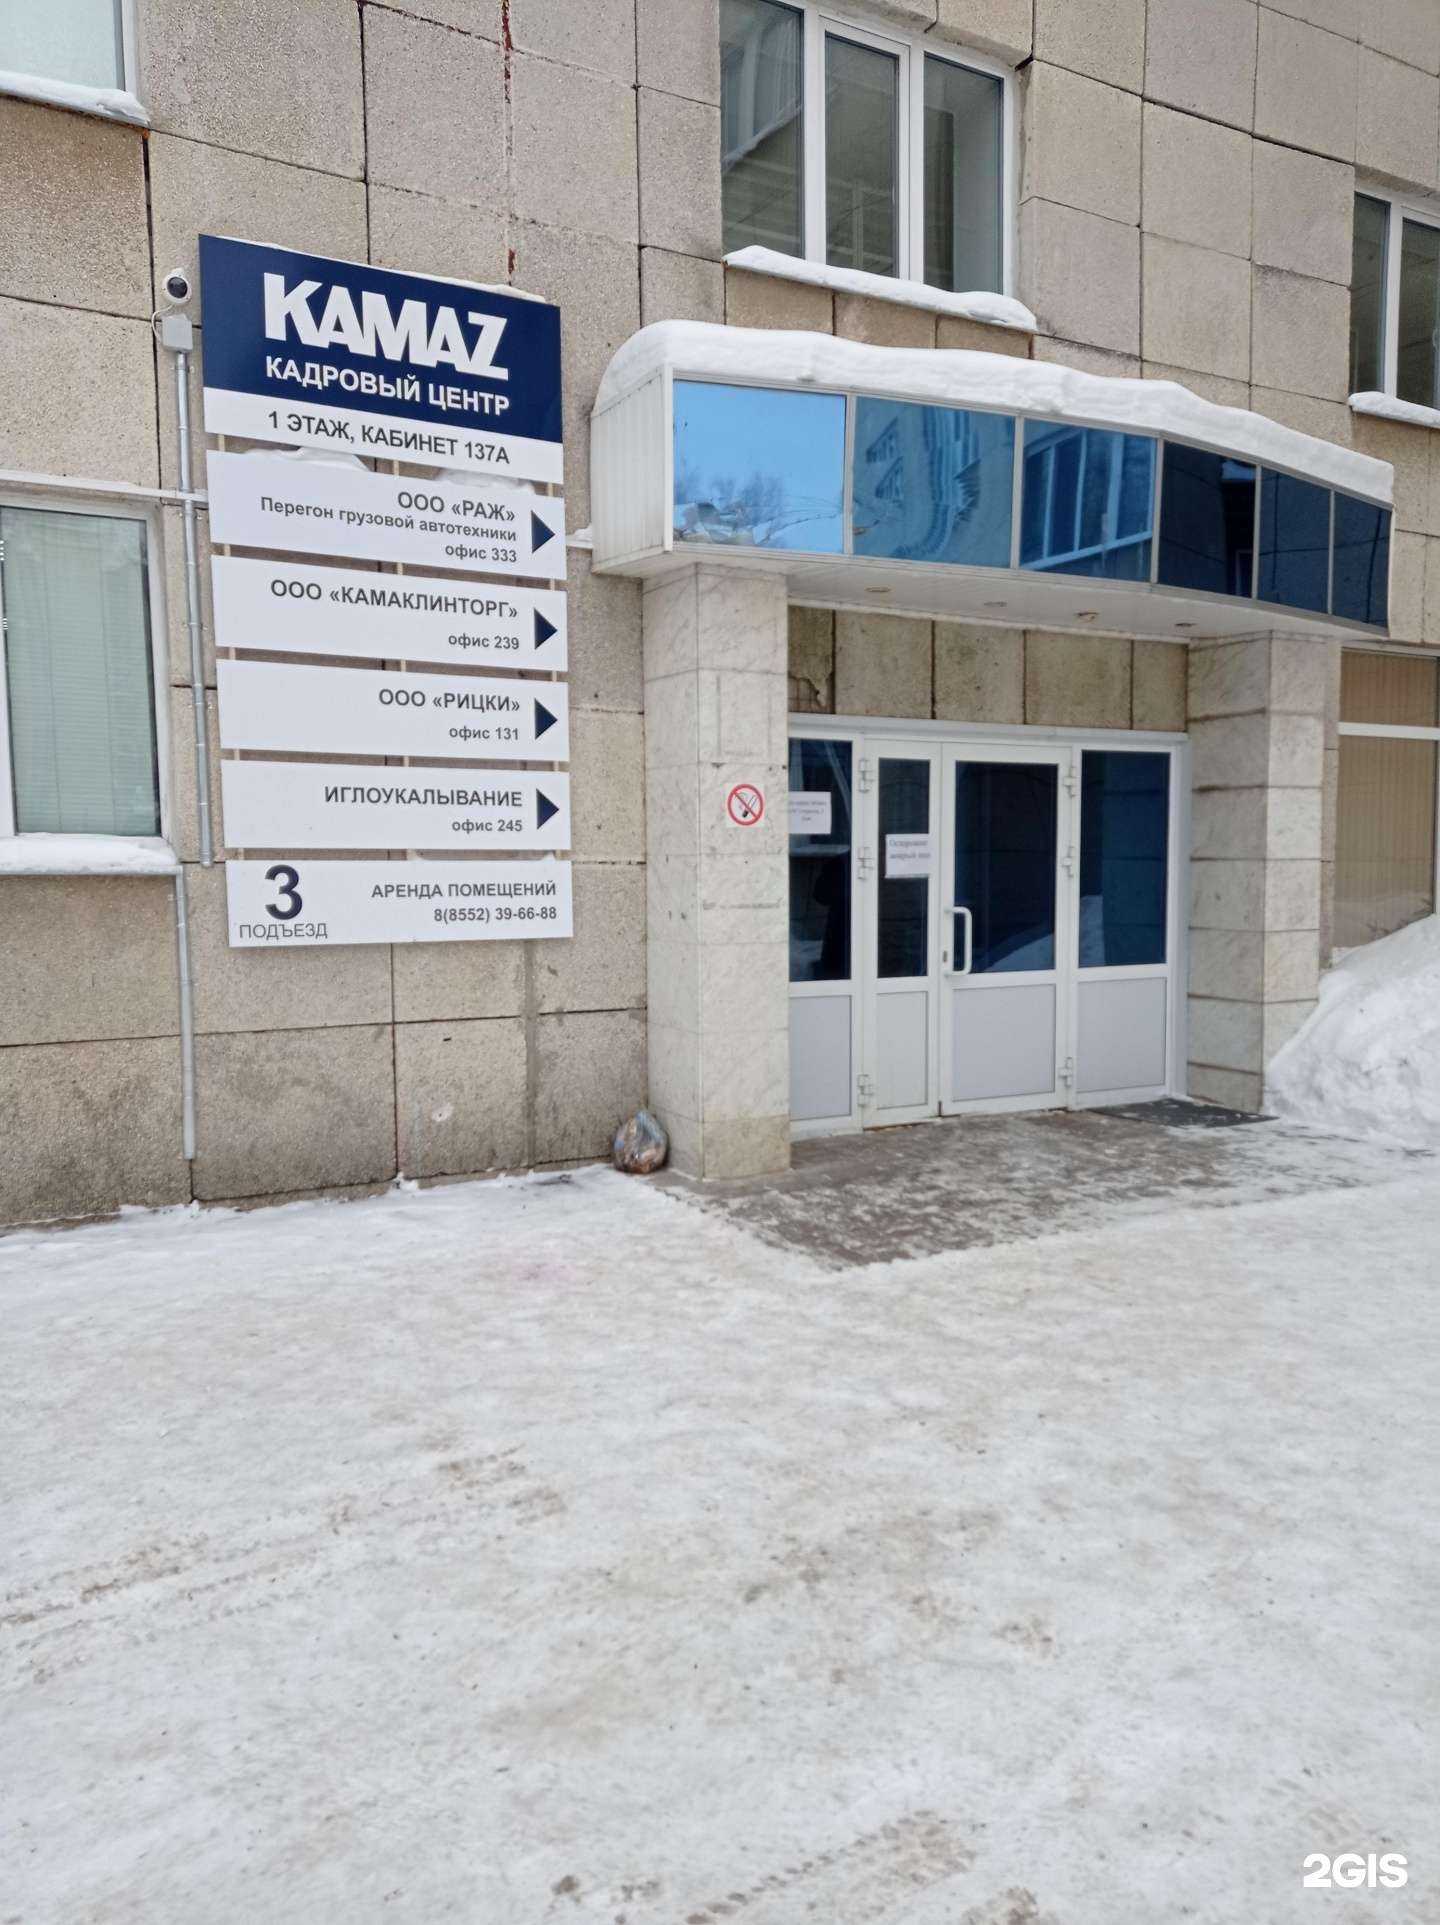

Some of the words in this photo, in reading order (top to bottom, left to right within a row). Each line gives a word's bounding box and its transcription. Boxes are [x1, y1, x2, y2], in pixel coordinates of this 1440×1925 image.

[263, 272, 509, 381] KAMAZ
[265, 355, 422, 402] КАДРОВЫЙ
[428, 386, 510, 416] ЦЕНТР
[269, 411, 277, 428] 1
[287, 414, 354, 443] ЭТАЖ,
[362, 425, 458, 455] КАБИНЕТ
[465, 441, 510, 464] 137А
[398, 492, 444, 512] ООО
[452, 500, 515, 521] «РАЖ»
[261, 497, 333, 518] Перегон
[339, 510, 414, 529] грузовой
[419, 521, 516, 541] автотехники
[445, 544, 486, 560] офис
[492, 548, 517, 563] 333
[271, 580, 321, 600] ООО
[330, 586, 517, 617] «КАМАКЛИНТОРГ»
[449, 633, 489, 649] офис
[494, 636, 519, 650] 239
[379, 689, 425, 707] ООО
[433, 693, 519, 713] «РИЦКИ»
[449, 726, 490, 741] офис
[496, 727, 518, 740] 131
[325, 786, 522, 807] ИГЛОУКАЛЫВАНИЕ
[452, 819, 492, 834] офис
[498, 819, 522, 832] 245
[264, 864, 303, 921] 3
[371, 884, 443, 899] АРЕНДА
[448, 880, 556, 898] ПОМЕЩЕНИЙ
[433, 908, 491, 924] 8(8552)
[496, 907, 556, 920] 39-66-88
[240, 923, 328, 940] ПОДЪЕЗД
